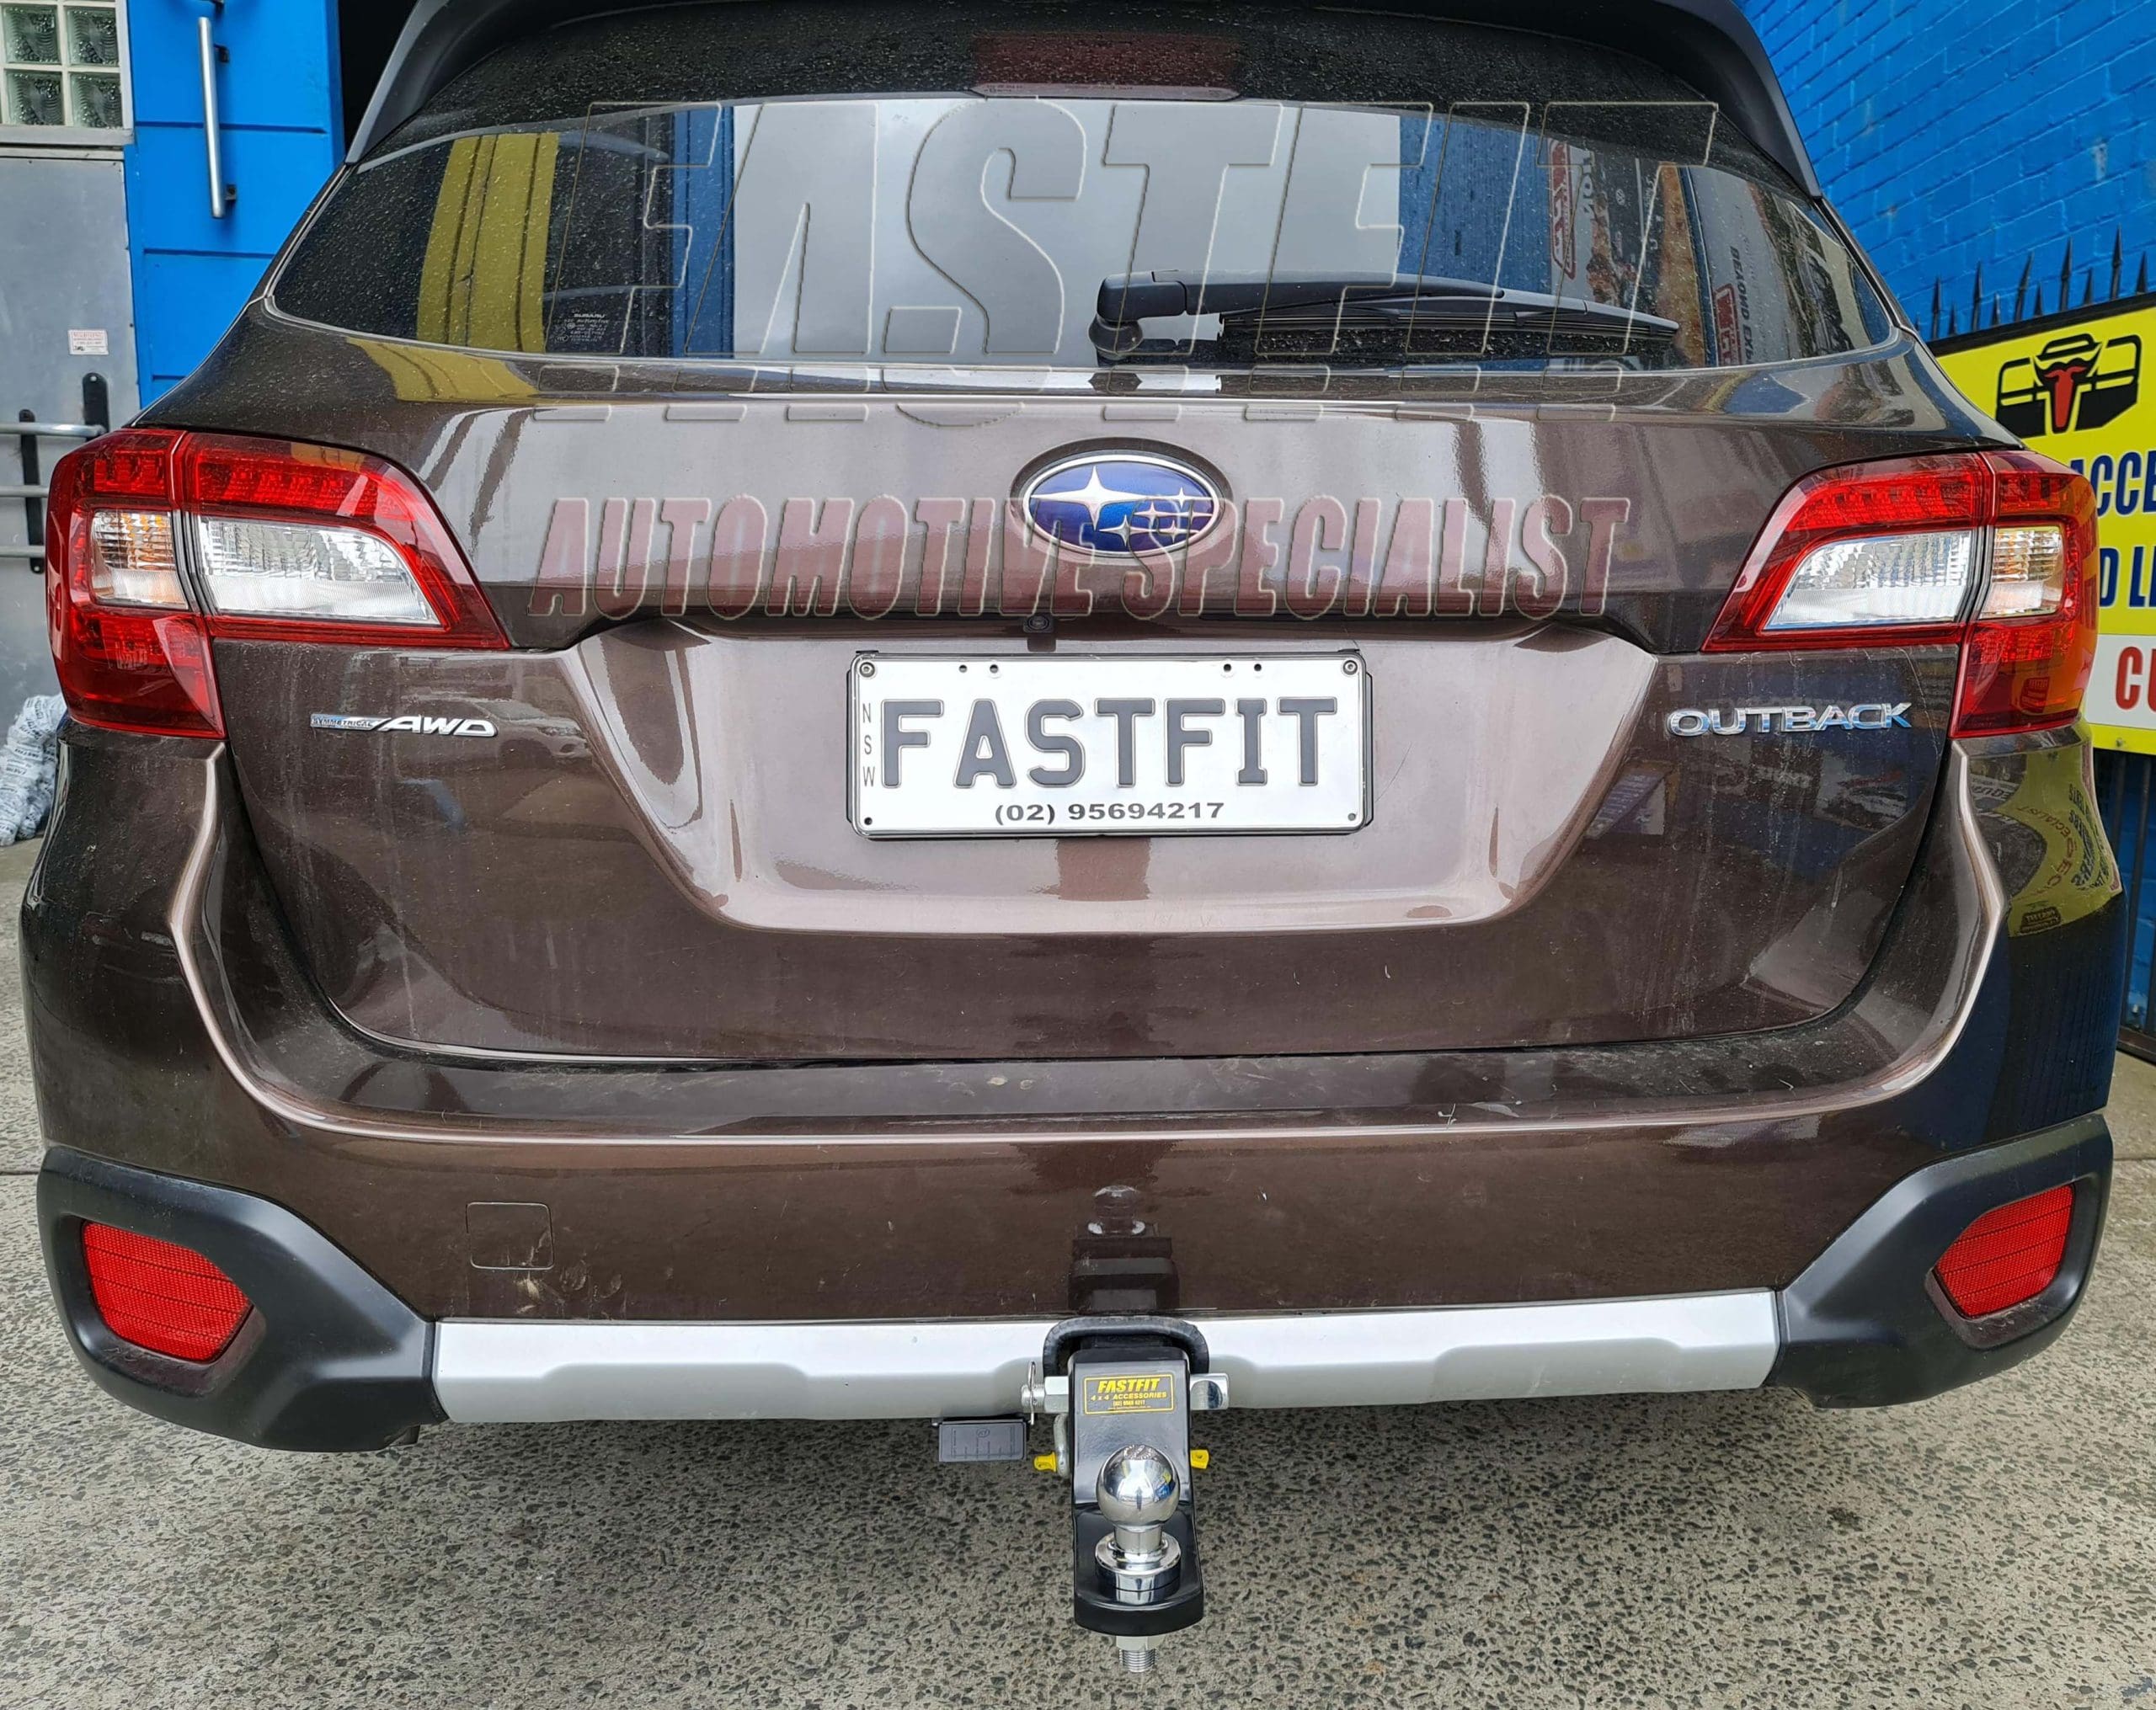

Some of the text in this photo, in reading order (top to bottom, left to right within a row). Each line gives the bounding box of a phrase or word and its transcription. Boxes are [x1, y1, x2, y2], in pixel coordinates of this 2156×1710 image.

[312, 715, 498, 737] SYMMETRICAL AWD
[1667, 702, 1912, 737] OUTBACK
[880, 696, 1338, 789] FASTFIT
[995, 802, 1225, 825] (02) 95694217
[1097, 1377, 1160, 1393] FASTFIT
[1113, 1392, 1166, 1400] ACCESSORIES
